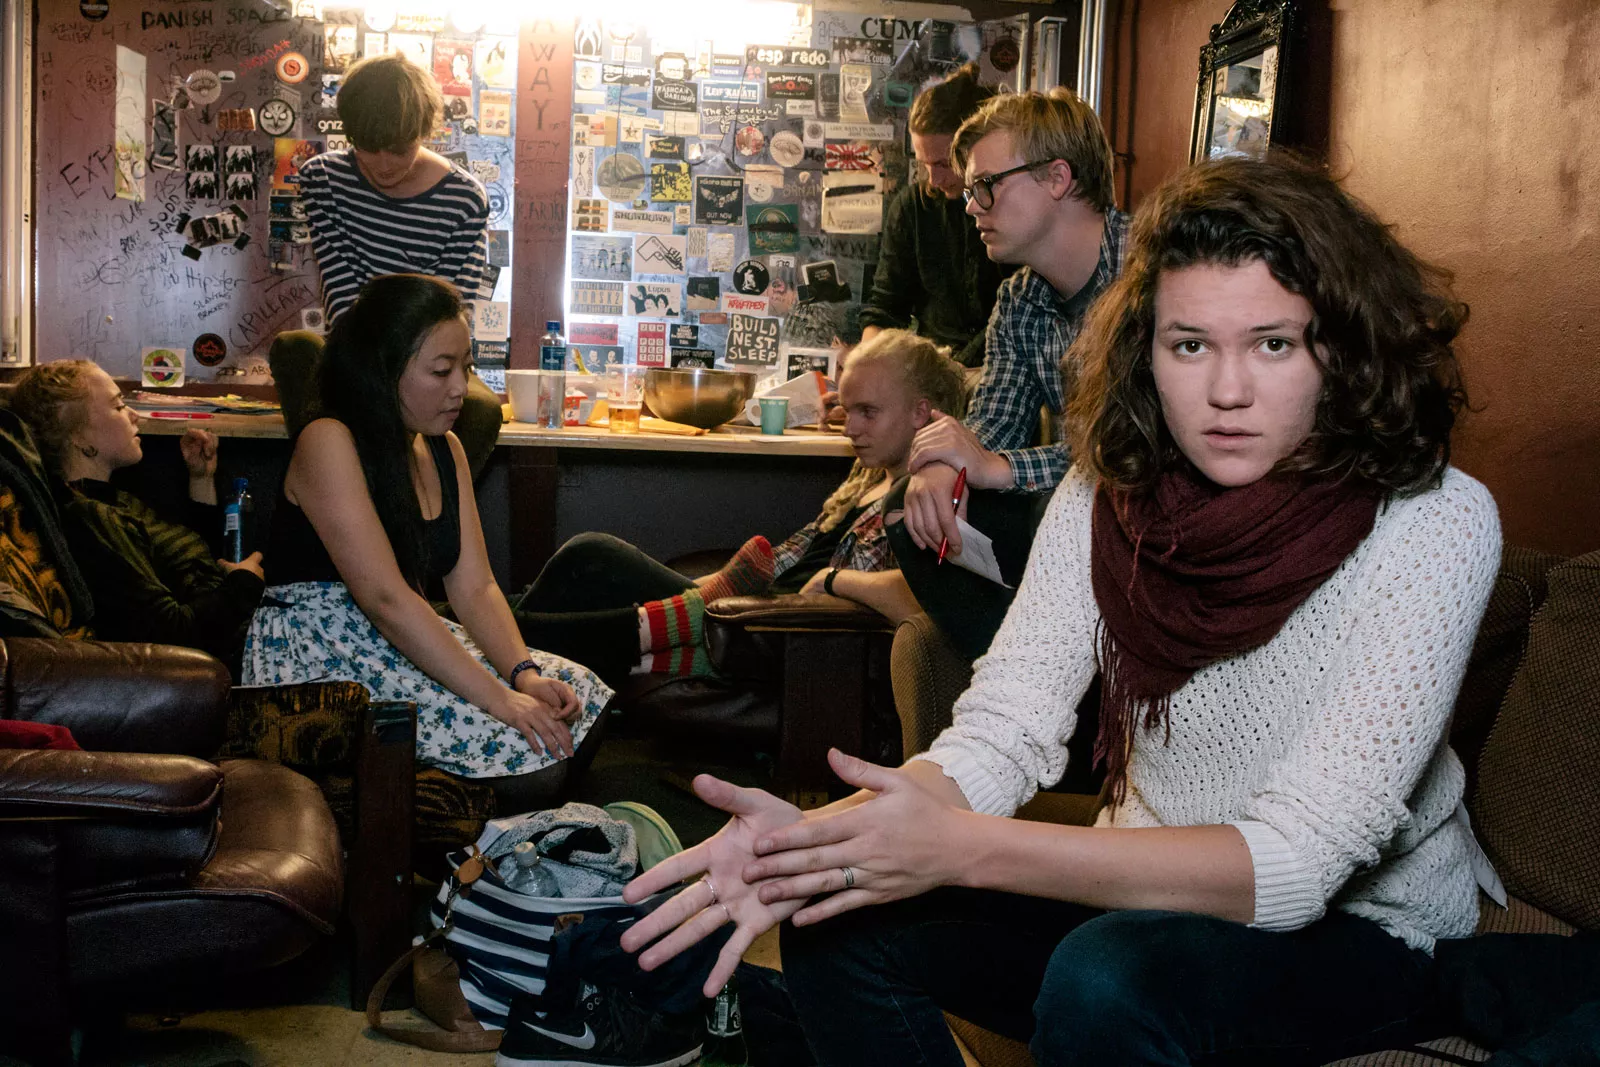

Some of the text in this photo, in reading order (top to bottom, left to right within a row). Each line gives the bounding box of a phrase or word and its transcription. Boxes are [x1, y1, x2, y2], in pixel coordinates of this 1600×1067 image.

[141, 9, 213, 30] DANISH
[185, 266, 247, 295] Hipster
[733, 314, 777, 336] BUILD
[728, 346, 777, 362] SLEEP
